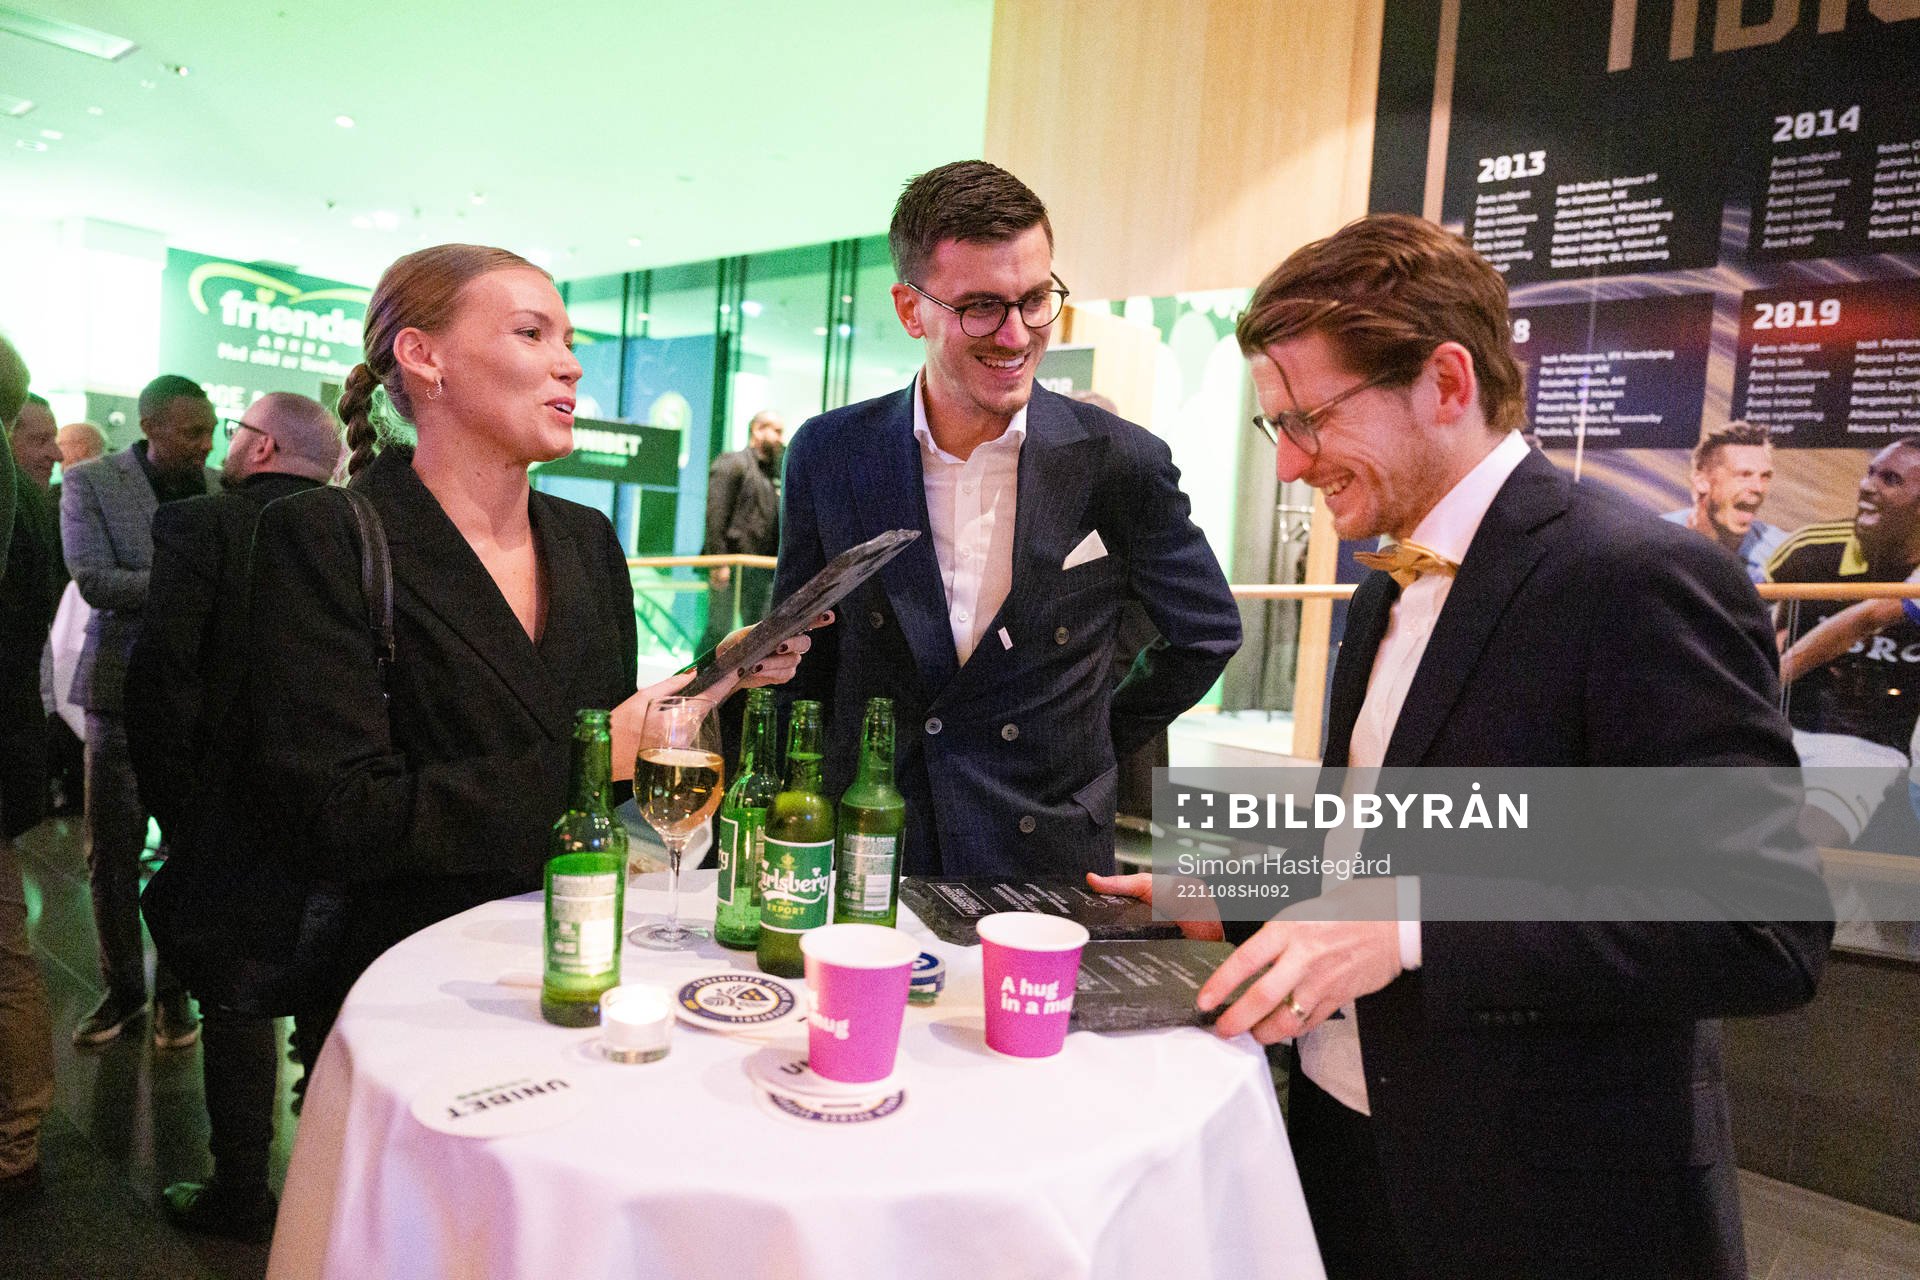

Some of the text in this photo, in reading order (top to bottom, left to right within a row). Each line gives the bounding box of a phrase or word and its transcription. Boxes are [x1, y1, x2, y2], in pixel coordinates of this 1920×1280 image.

[1771, 104, 1861, 144] 2014
[1477, 150, 1547, 184] 2013
[1752, 298, 1841, 330] 2019
[767, 903, 806, 916] EXPORT
[1001, 976, 1016, 994] A
[1020, 978, 1059, 1001] hug
[1001, 992, 1020, 1013] in
[1025, 1001, 1039, 1015] a
[448, 1078, 570, 1119] UNIBET
